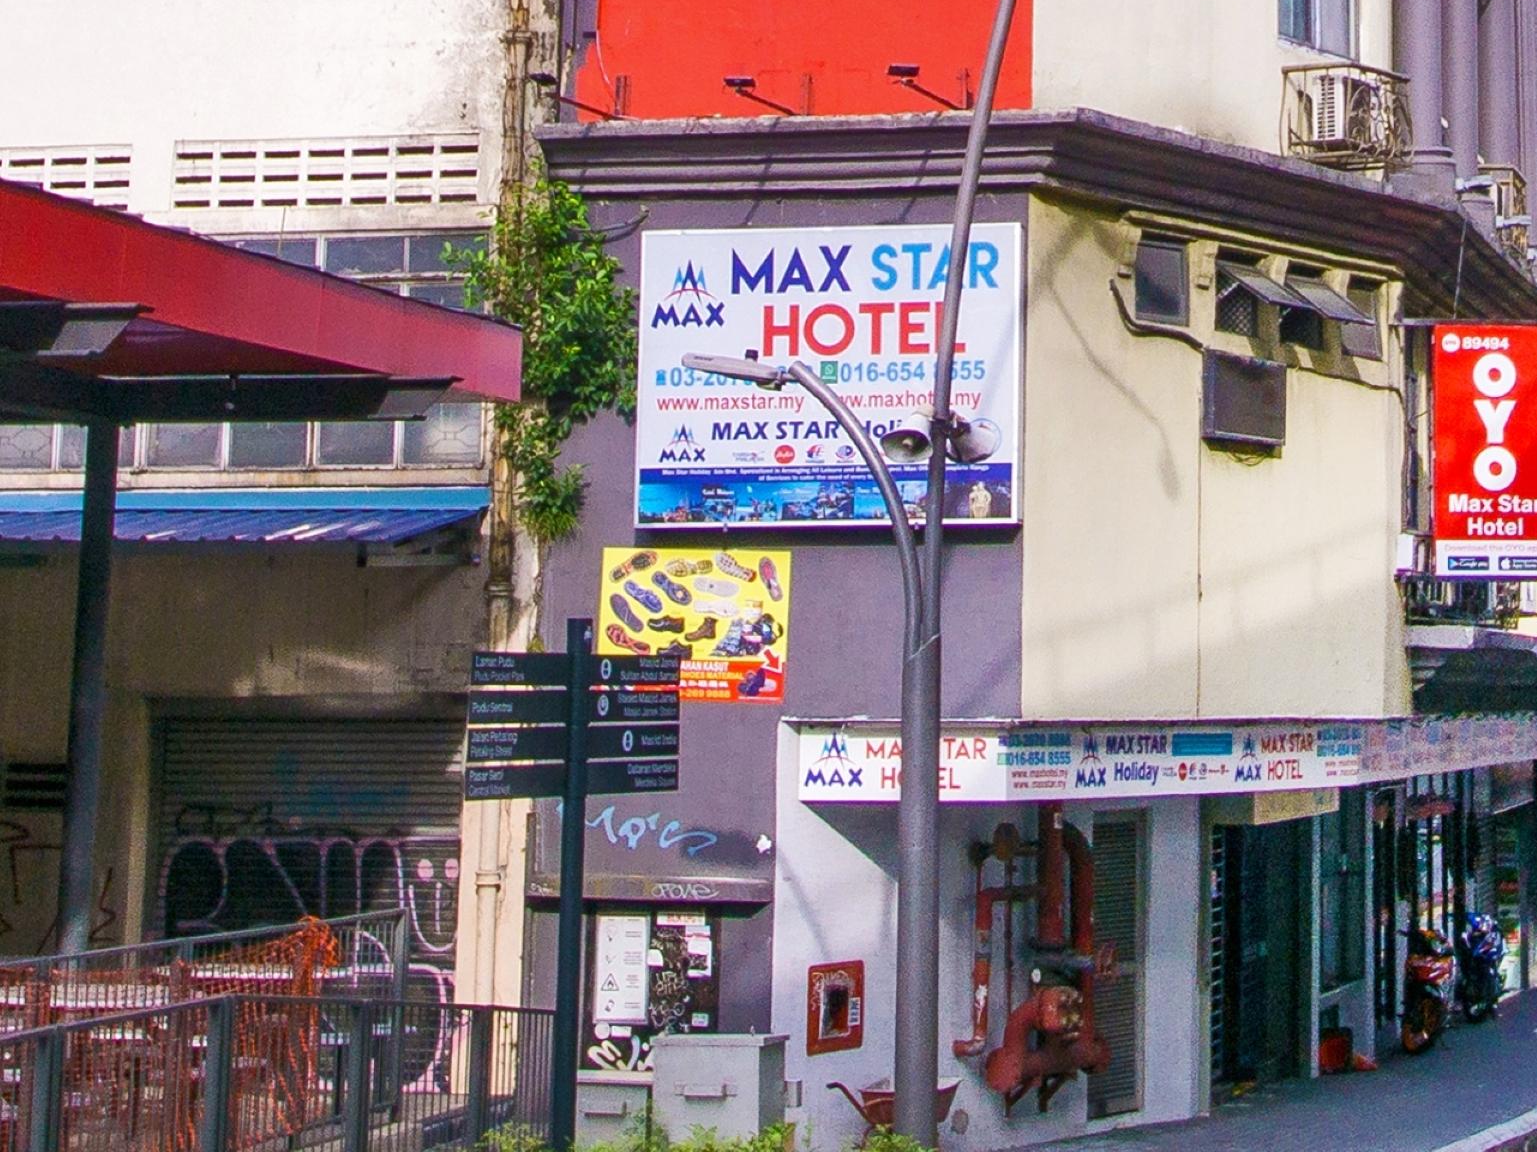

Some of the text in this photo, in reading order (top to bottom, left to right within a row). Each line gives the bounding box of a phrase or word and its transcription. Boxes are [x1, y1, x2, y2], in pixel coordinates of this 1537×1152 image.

[732, 242, 999, 295] MAX STAR
[651, 302, 725, 329] MAX
[763, 301, 966, 357] HOTEL
[840, 361, 925, 383] 016-654
[933, 360, 985, 381] 555
[657, 394, 804, 413] www.maxstar.my
[711, 422, 769, 440] MAX
[775, 421, 840, 439] STAR
[1473, 352, 1517, 492] OYO
[659, 448, 705, 463] MAX
[1449, 494, 1492, 513] Max
[1467, 518, 1524, 536] Hotel
[1106, 735, 1135, 754] MAX
[1137, 734, 1167, 754] STAR
[804, 768, 863, 787] MAX
[1075, 767, 1107, 788] MAX
[1114, 762, 1159, 786] Holiday
[1234, 763, 1262, 783] MAX
[1267, 758, 1303, 781] HOTEL
